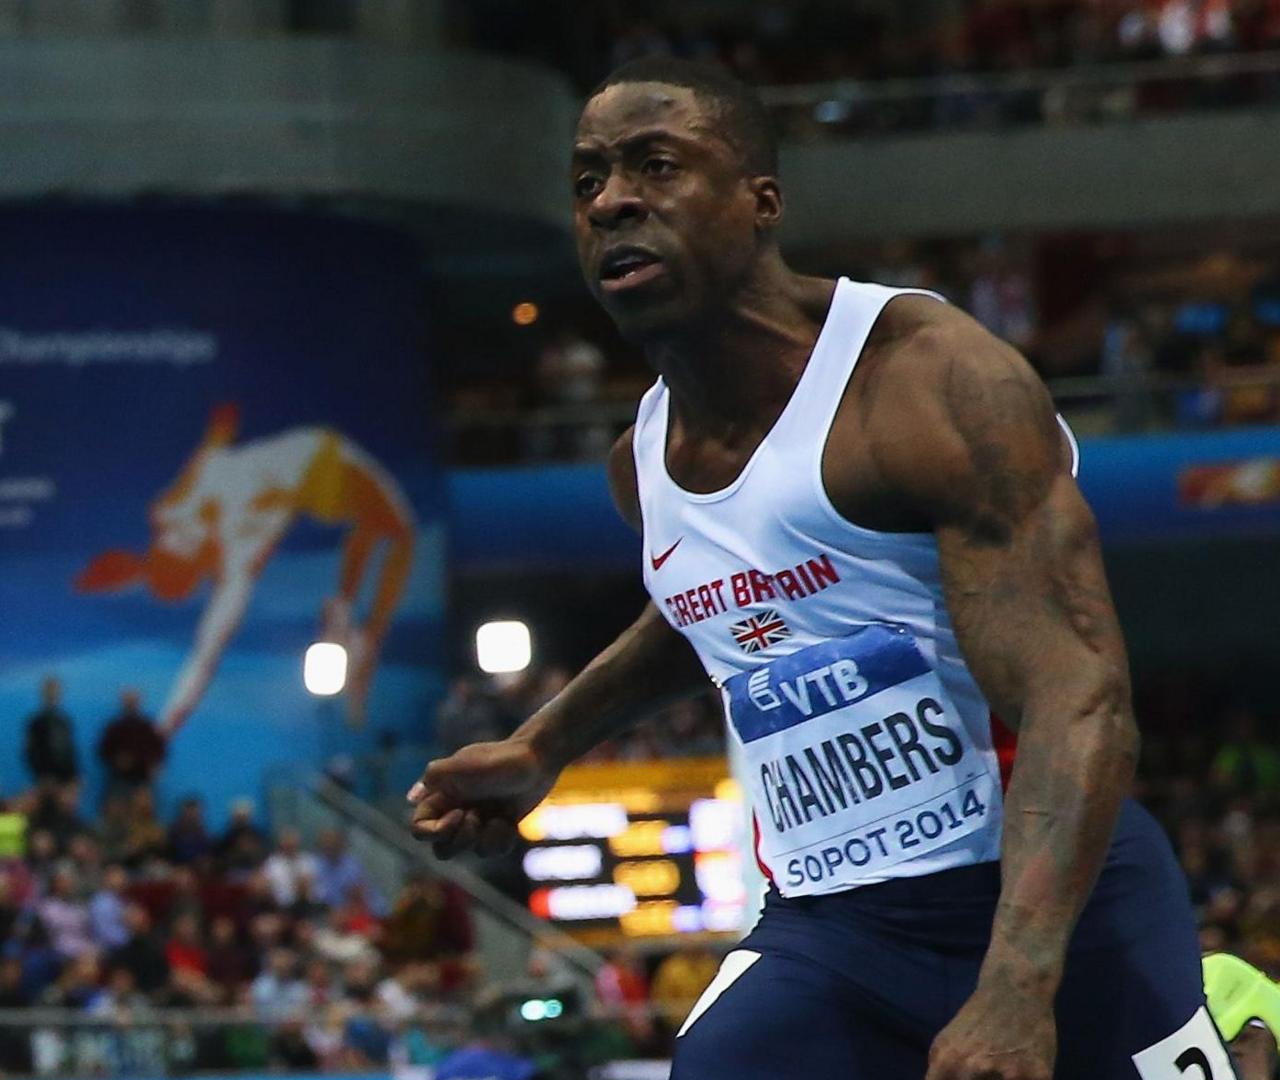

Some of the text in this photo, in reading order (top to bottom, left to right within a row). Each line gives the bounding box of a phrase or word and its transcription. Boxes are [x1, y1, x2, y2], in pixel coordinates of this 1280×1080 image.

[779, 658, 869, 716] VTB
[761, 697, 963, 833] CHAMBERS
[787, 828, 888, 887] SOPOT
[895, 789, 985, 849] 2014
